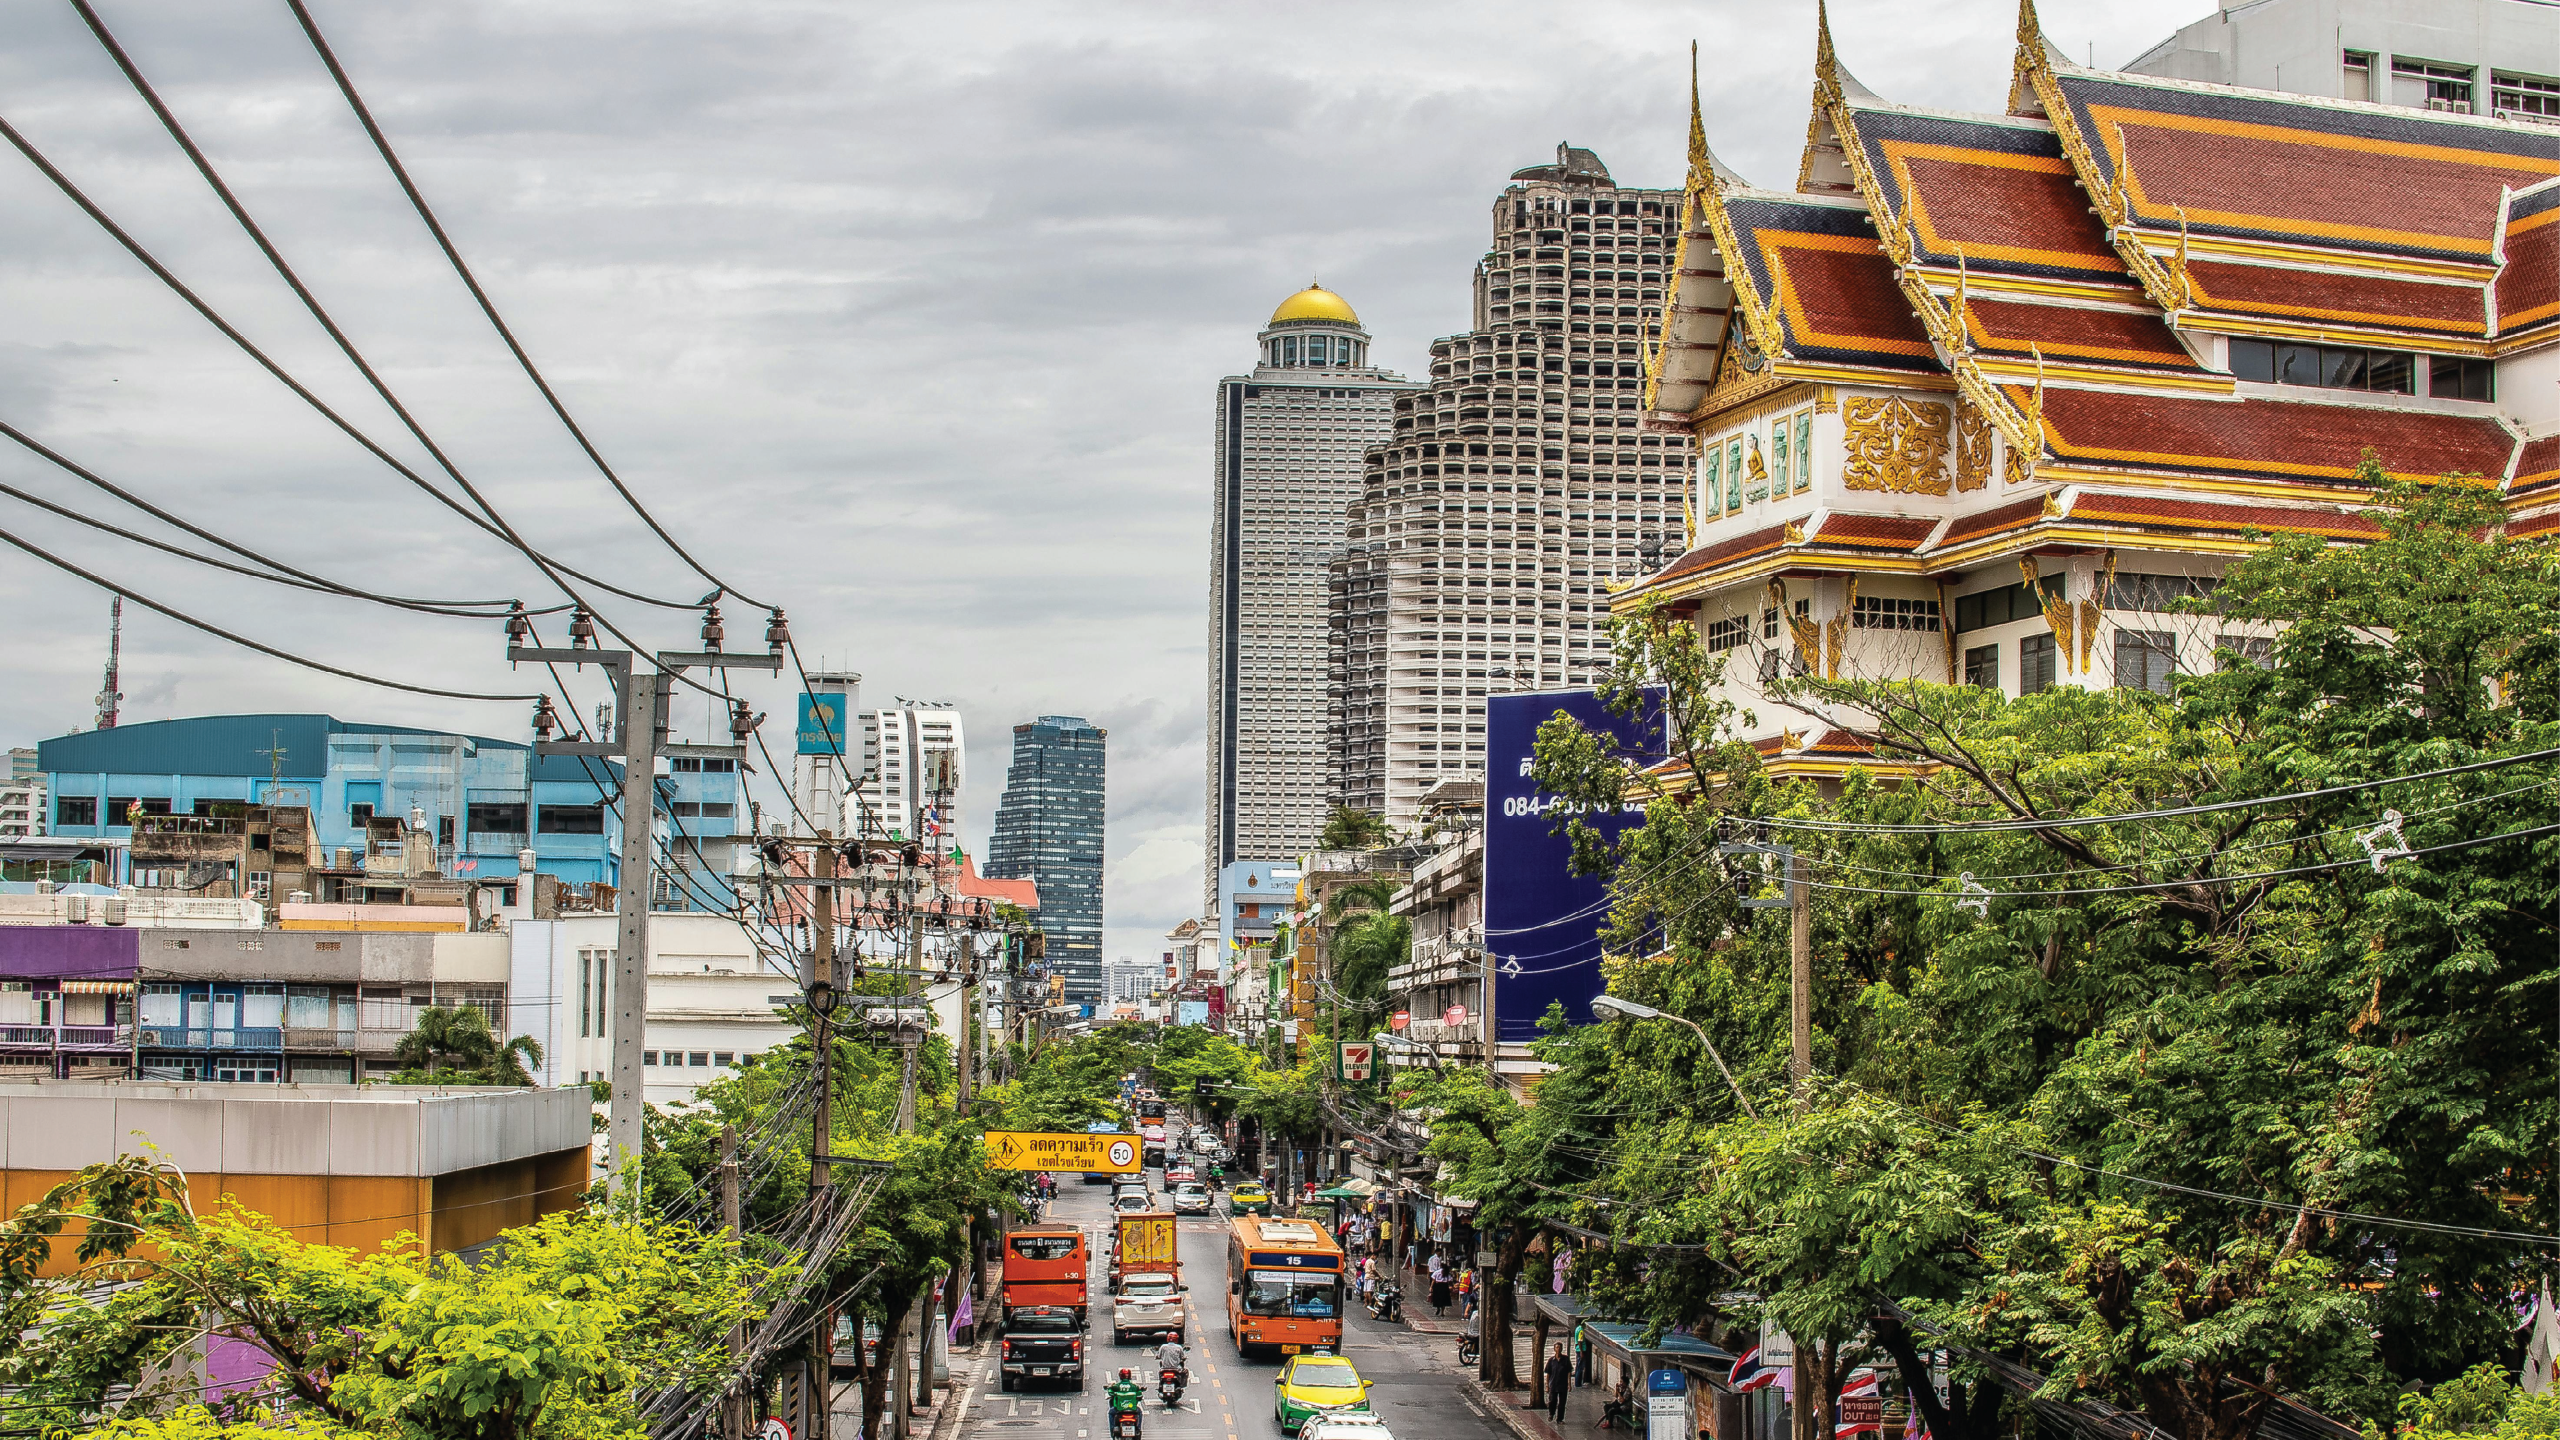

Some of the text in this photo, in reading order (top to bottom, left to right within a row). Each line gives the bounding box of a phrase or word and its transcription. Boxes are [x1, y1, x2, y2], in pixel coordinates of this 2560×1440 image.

[1346, 1047, 1369, 1079] 7
[1029, 1135, 1104, 1153] ลดความเร็ว
[1113, 1149, 1129, 1160] 50
[1037, 1153, 1095, 1168] เขตโรงเรียน
[1286, 1256, 1302, 1265] 15
[1844, 1402, 1880, 1410] ทางออก
[1844, 1411, 1865, 1420] OUT
